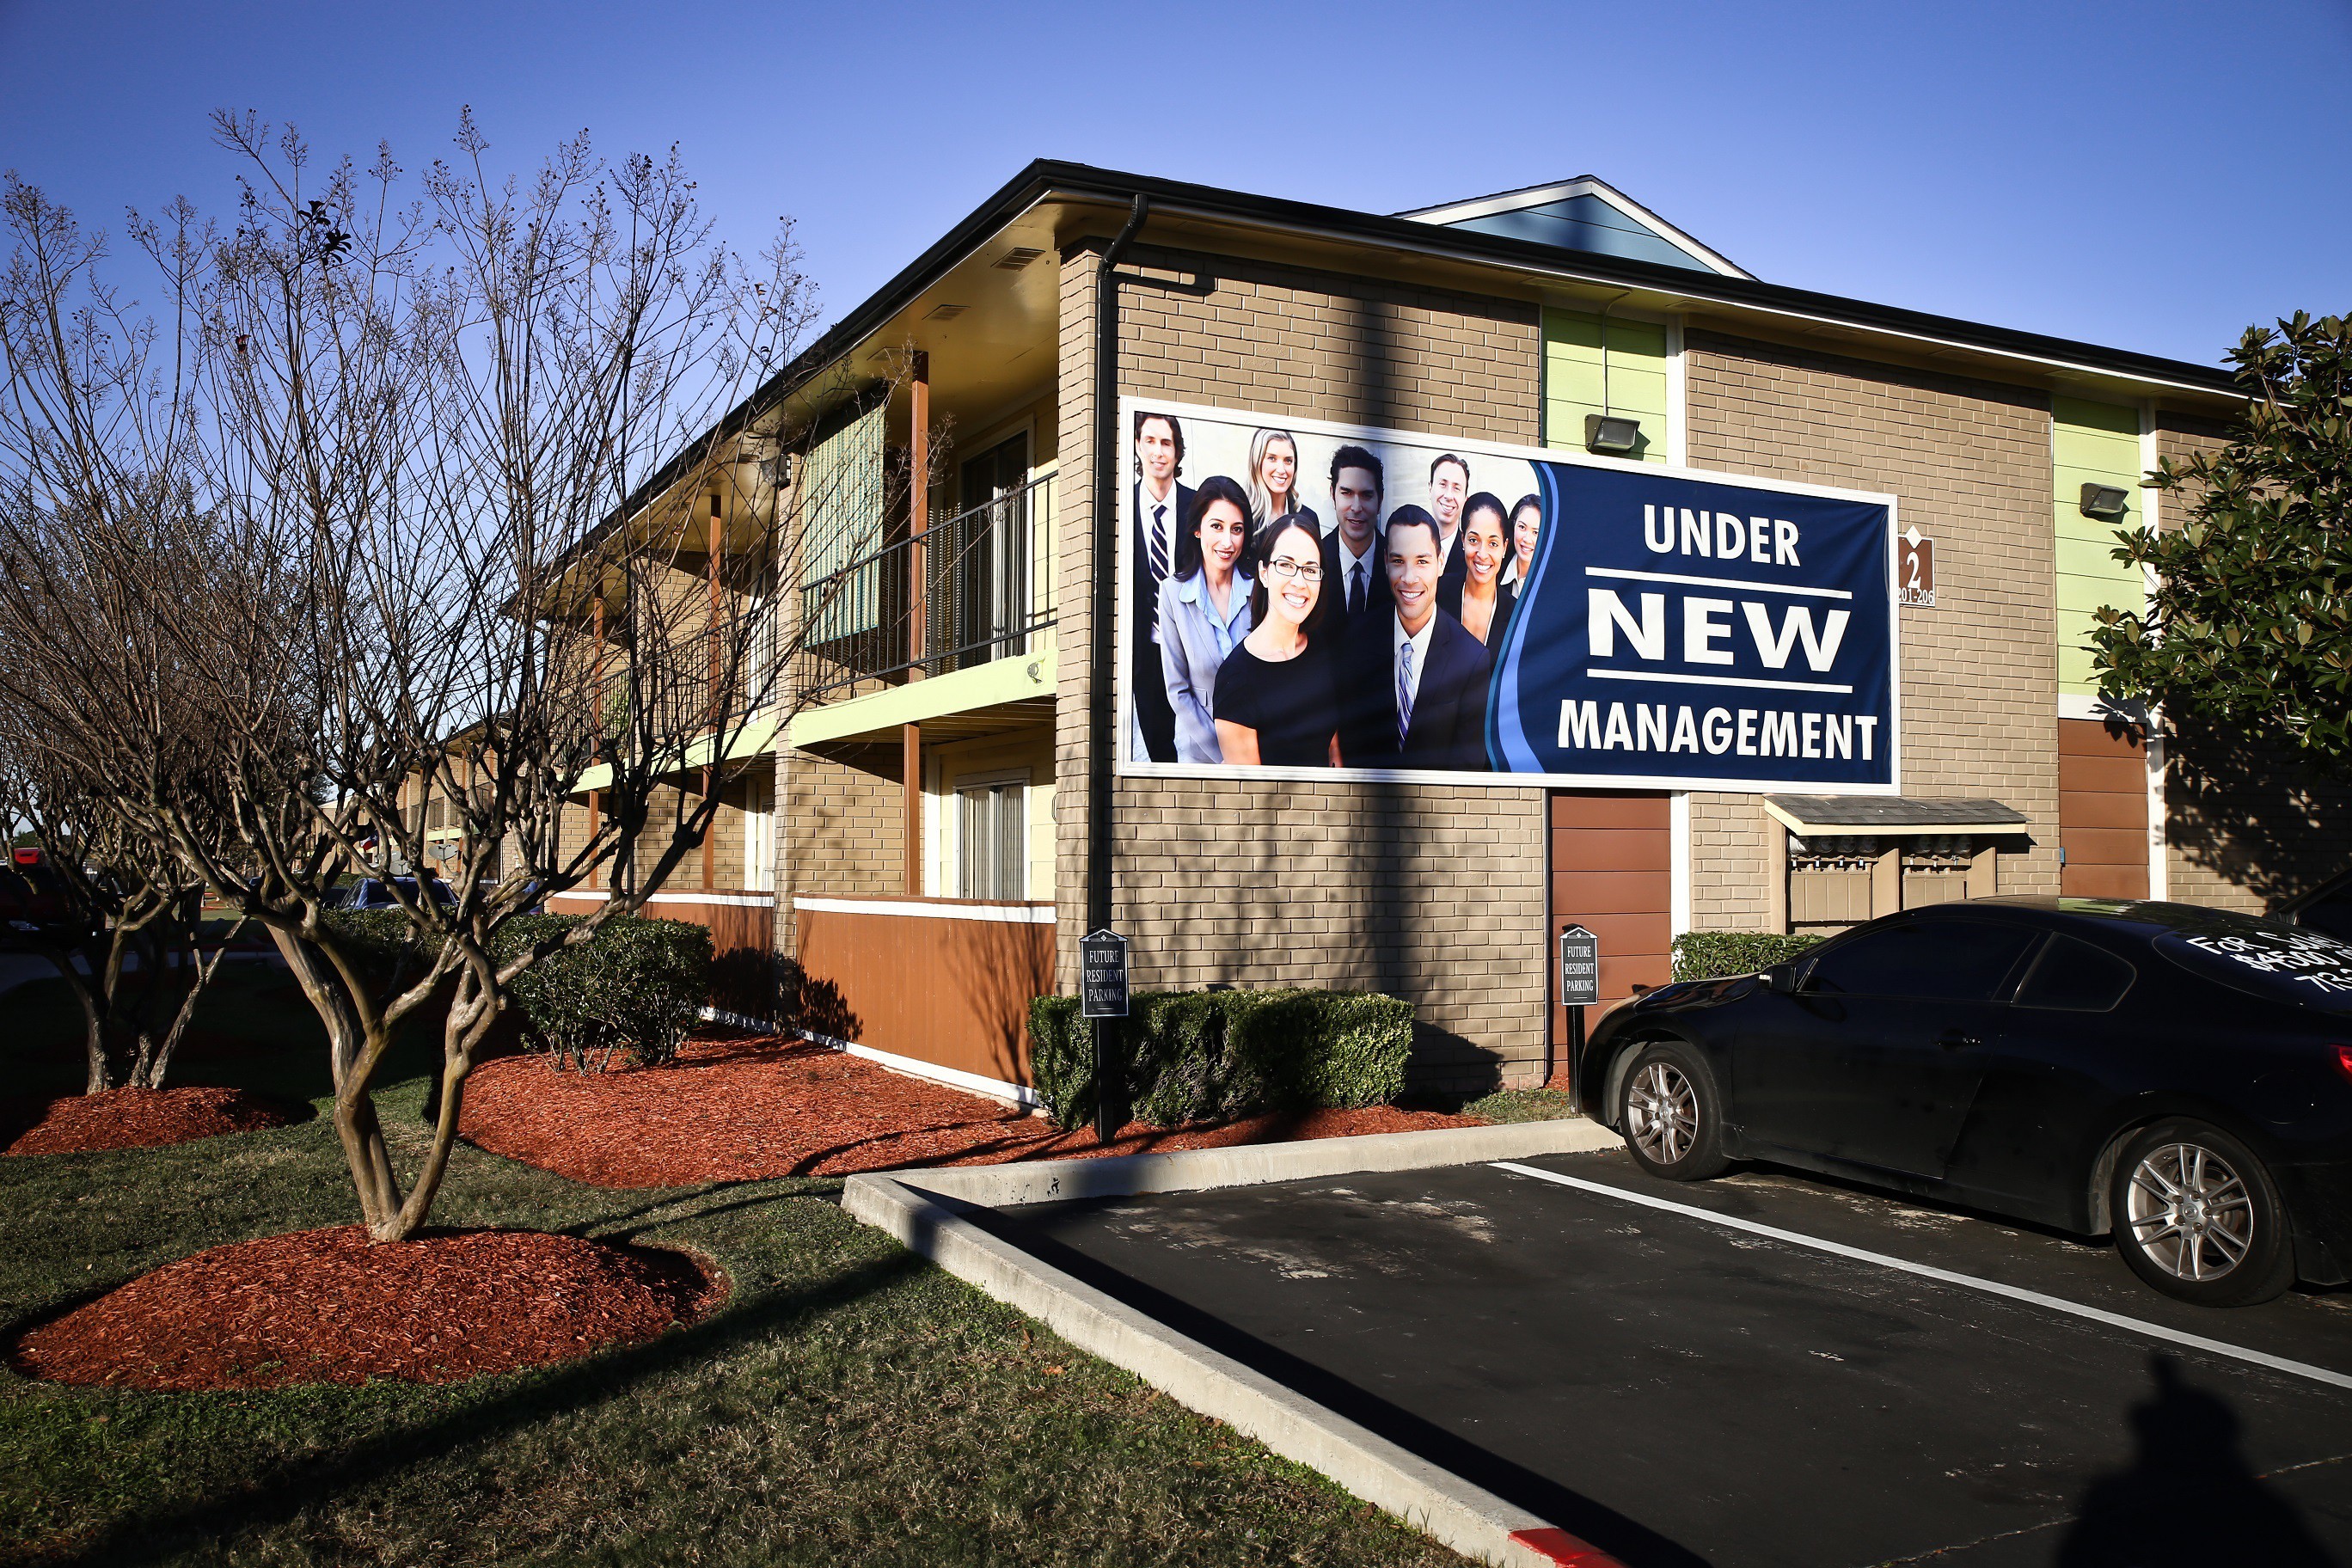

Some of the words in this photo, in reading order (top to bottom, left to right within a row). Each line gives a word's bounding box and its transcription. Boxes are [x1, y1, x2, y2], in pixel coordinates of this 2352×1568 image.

[1644, 504, 1801, 567] UNDER
[1907, 551, 1921, 589] 2
[1588, 588, 1851, 672] NEW
[1557, 699, 1878, 761] MANAGEMENT
[1089, 950, 1119, 963] FUTURE
[1567, 946, 1591, 958] FUTURE
[2229, 951, 2341, 972] $4500
[1087, 969, 1123, 983] RESIDENT
[1565, 963, 1594, 975] RESIDENT
[1566, 980, 1594, 992] PARKING
[1088, 988, 1123, 1001] PARKING
